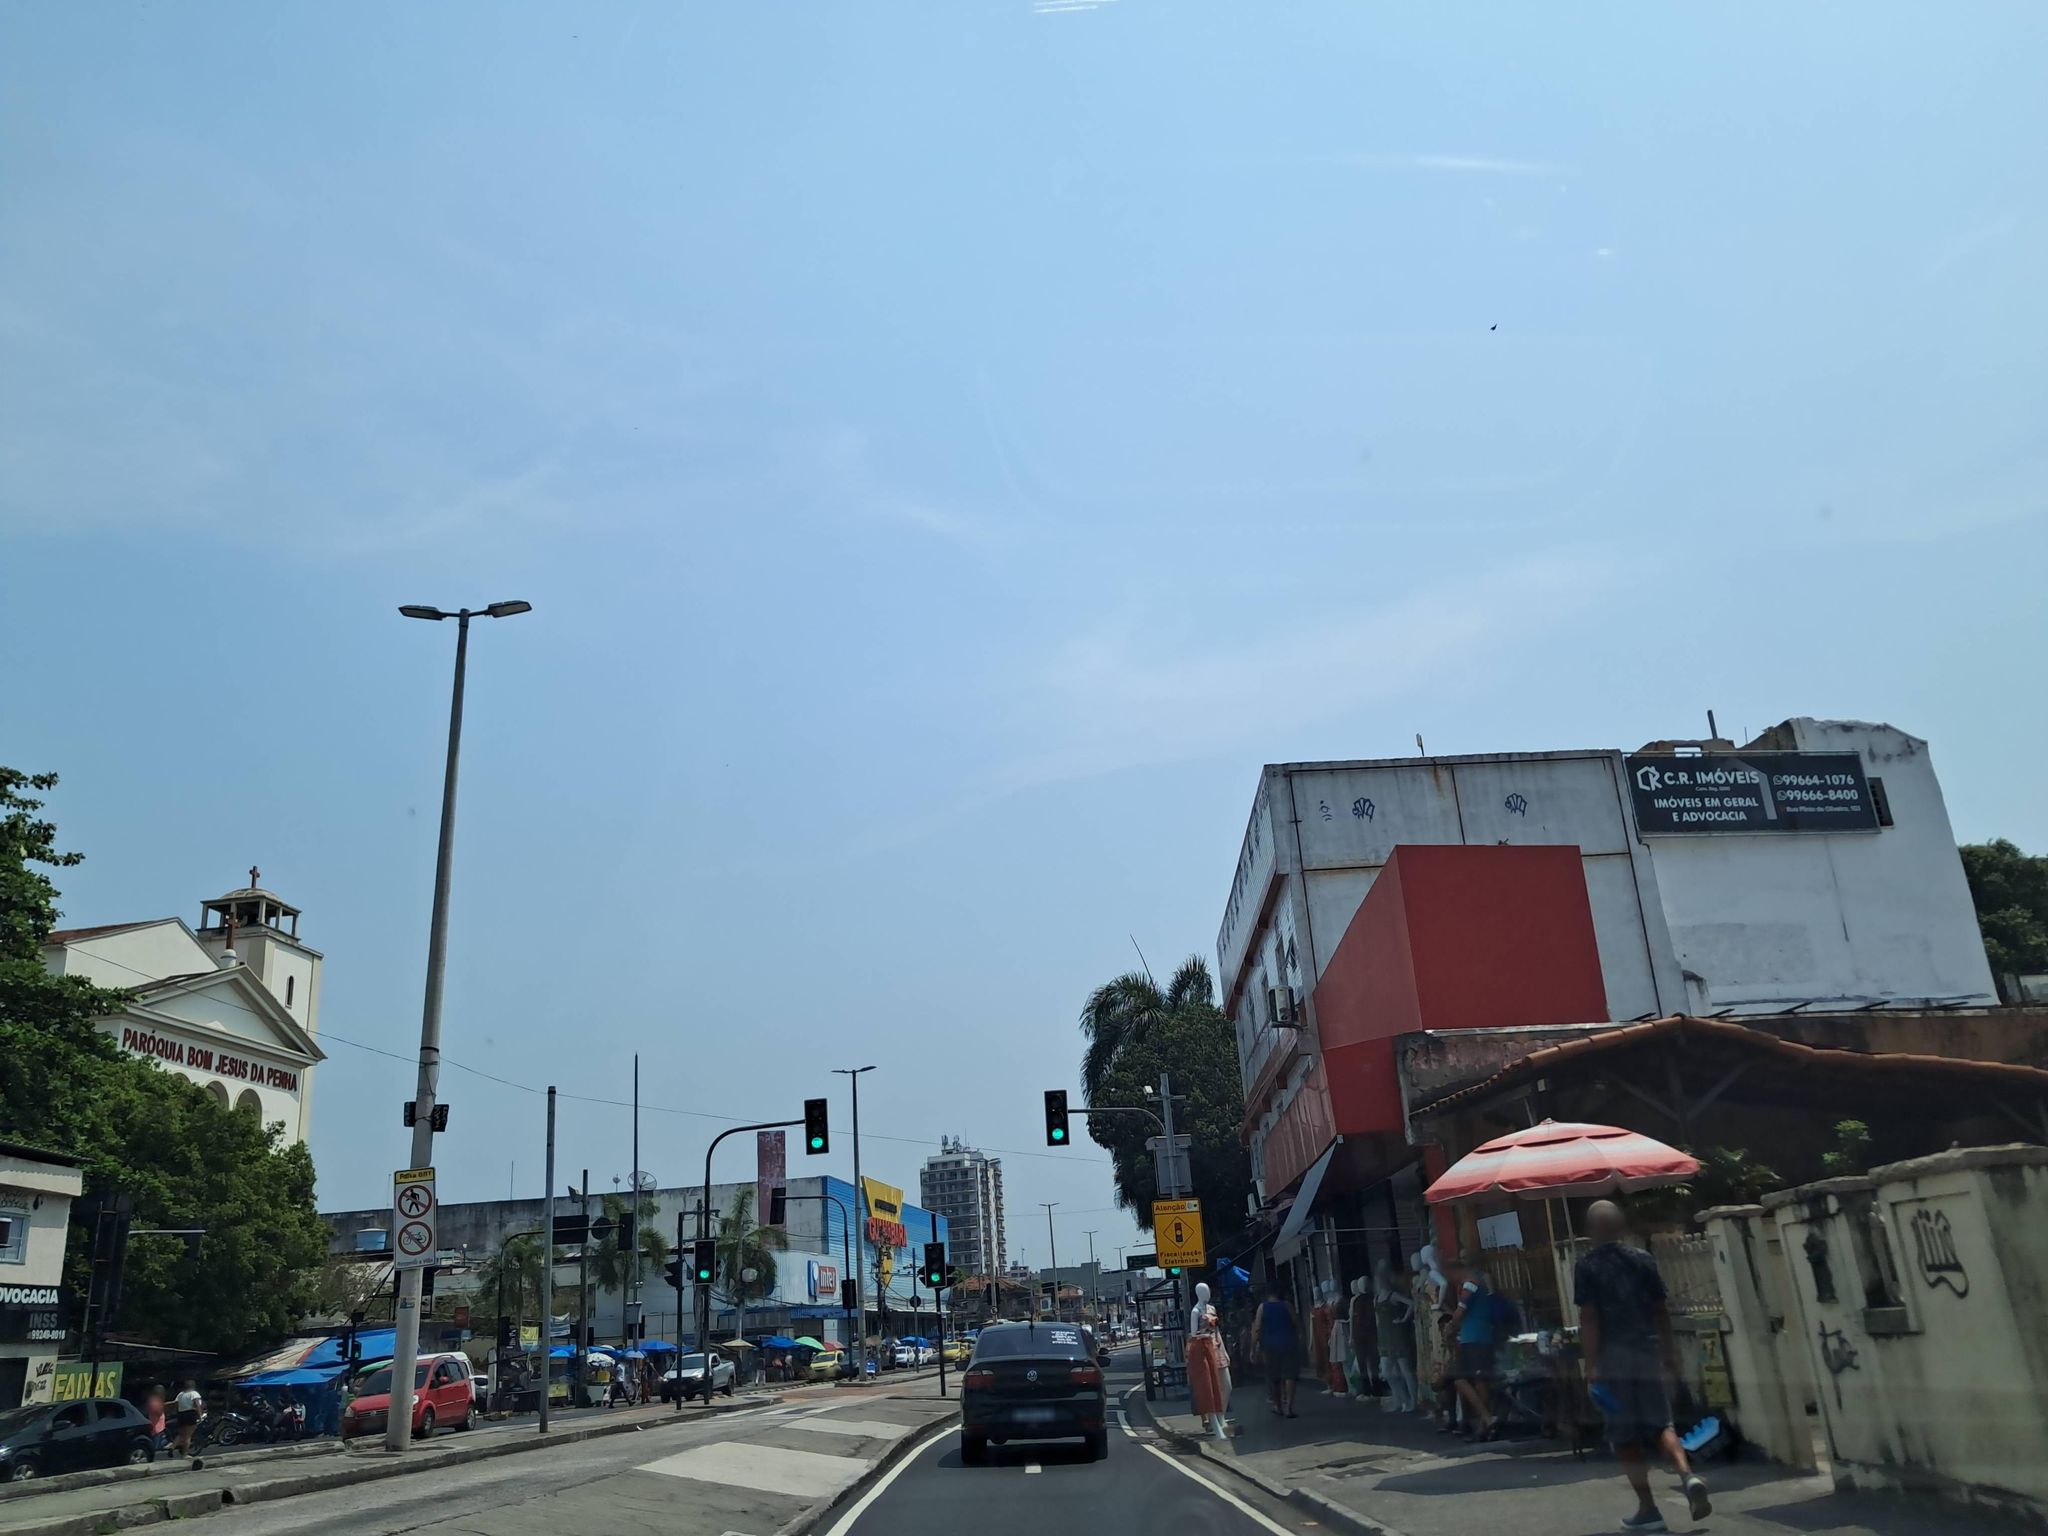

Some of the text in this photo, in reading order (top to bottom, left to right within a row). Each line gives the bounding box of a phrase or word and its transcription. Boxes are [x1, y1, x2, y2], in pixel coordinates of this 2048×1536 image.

[1664, 768, 1760, 785] C.R. IMÓVEIS
[1782, 775, 1854, 785] 99664-1076
[1654, 795, 1759, 808] IMÓVEIS EM GERAL
[1786, 789, 1858, 800] 99666-8400
[1672, 811, 1747, 821] E ADVOCACIA
[122, 1028, 298, 1092] PARÓQUIA BOM JESUS DA PENHA
[29, 1313, 58, 1328] INSS
[53, 1371, 116, 1402] FAIXAS
